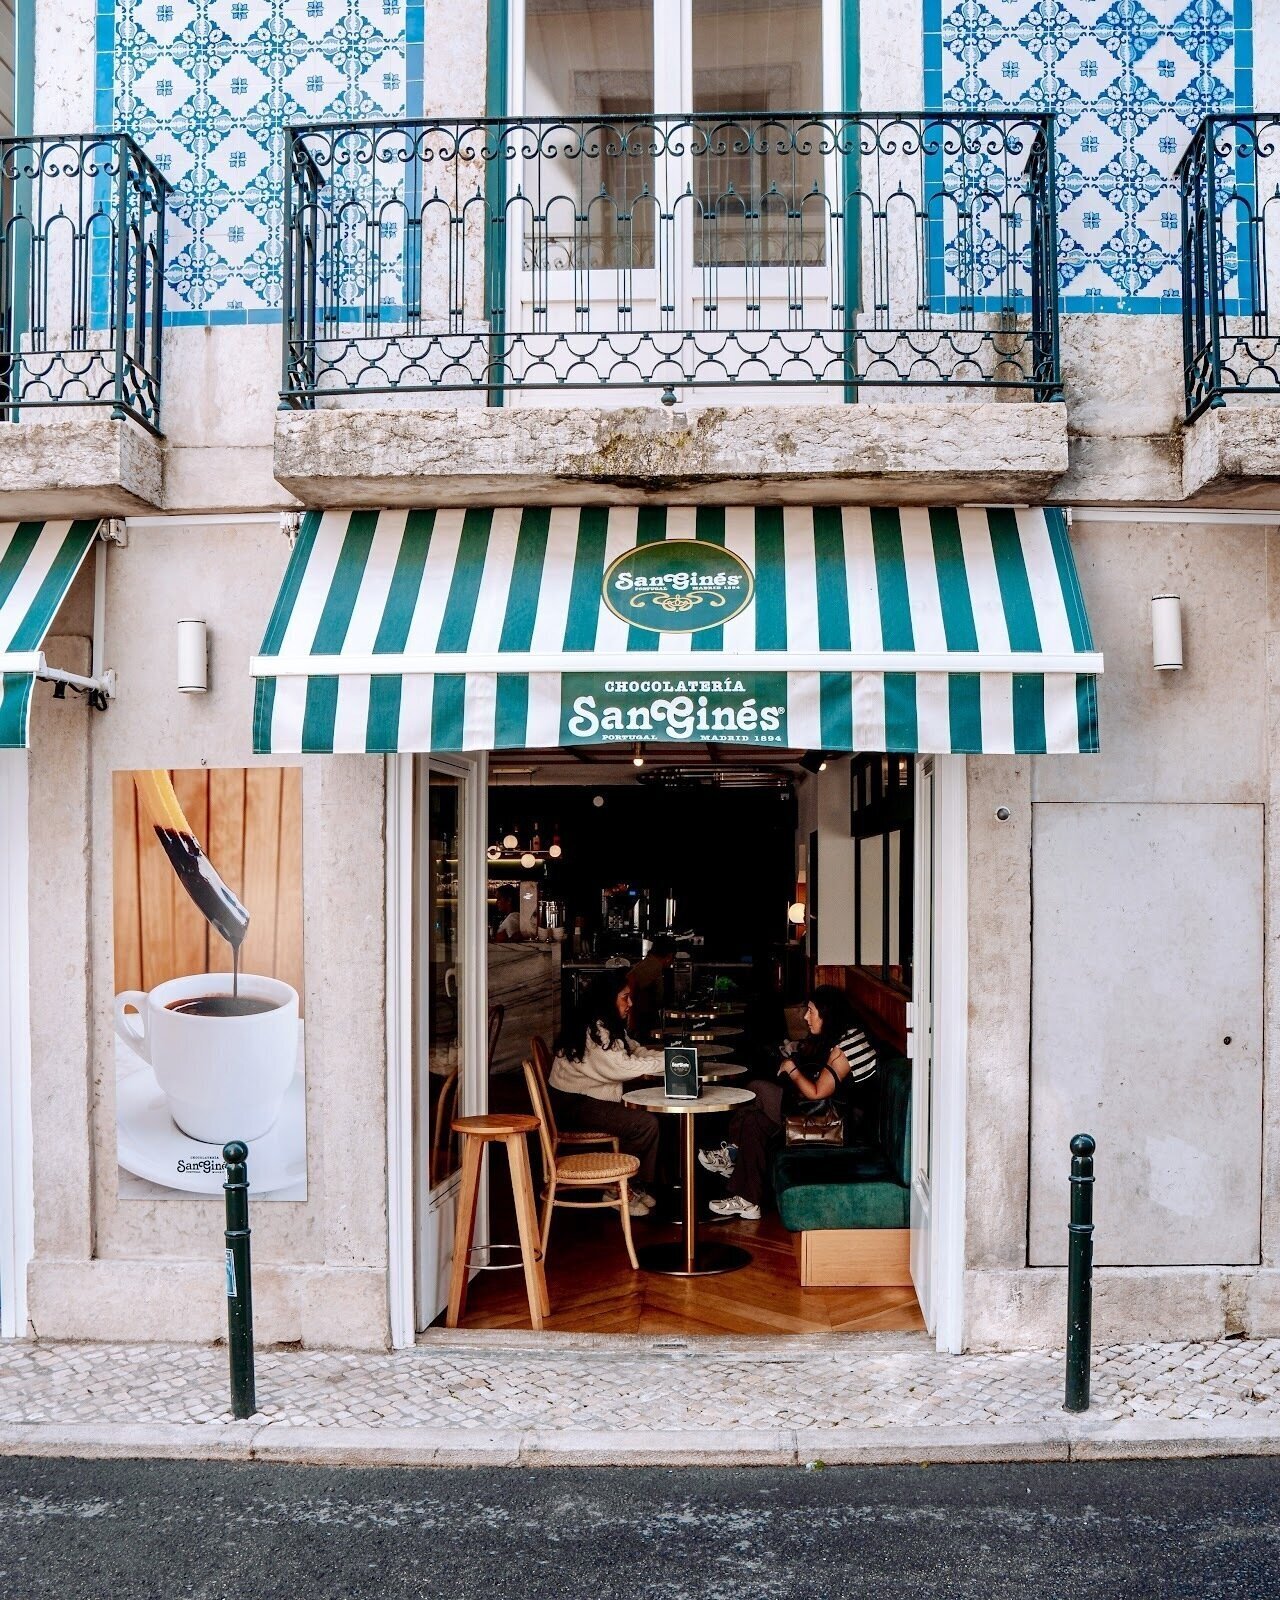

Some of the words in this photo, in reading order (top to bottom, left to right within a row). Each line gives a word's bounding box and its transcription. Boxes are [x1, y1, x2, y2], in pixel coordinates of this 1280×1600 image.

[604, 677, 746, 692] CHOCOLATERÍA
[700, 734, 749, 742] MADRID
[755, 734, 782, 742] 1894
